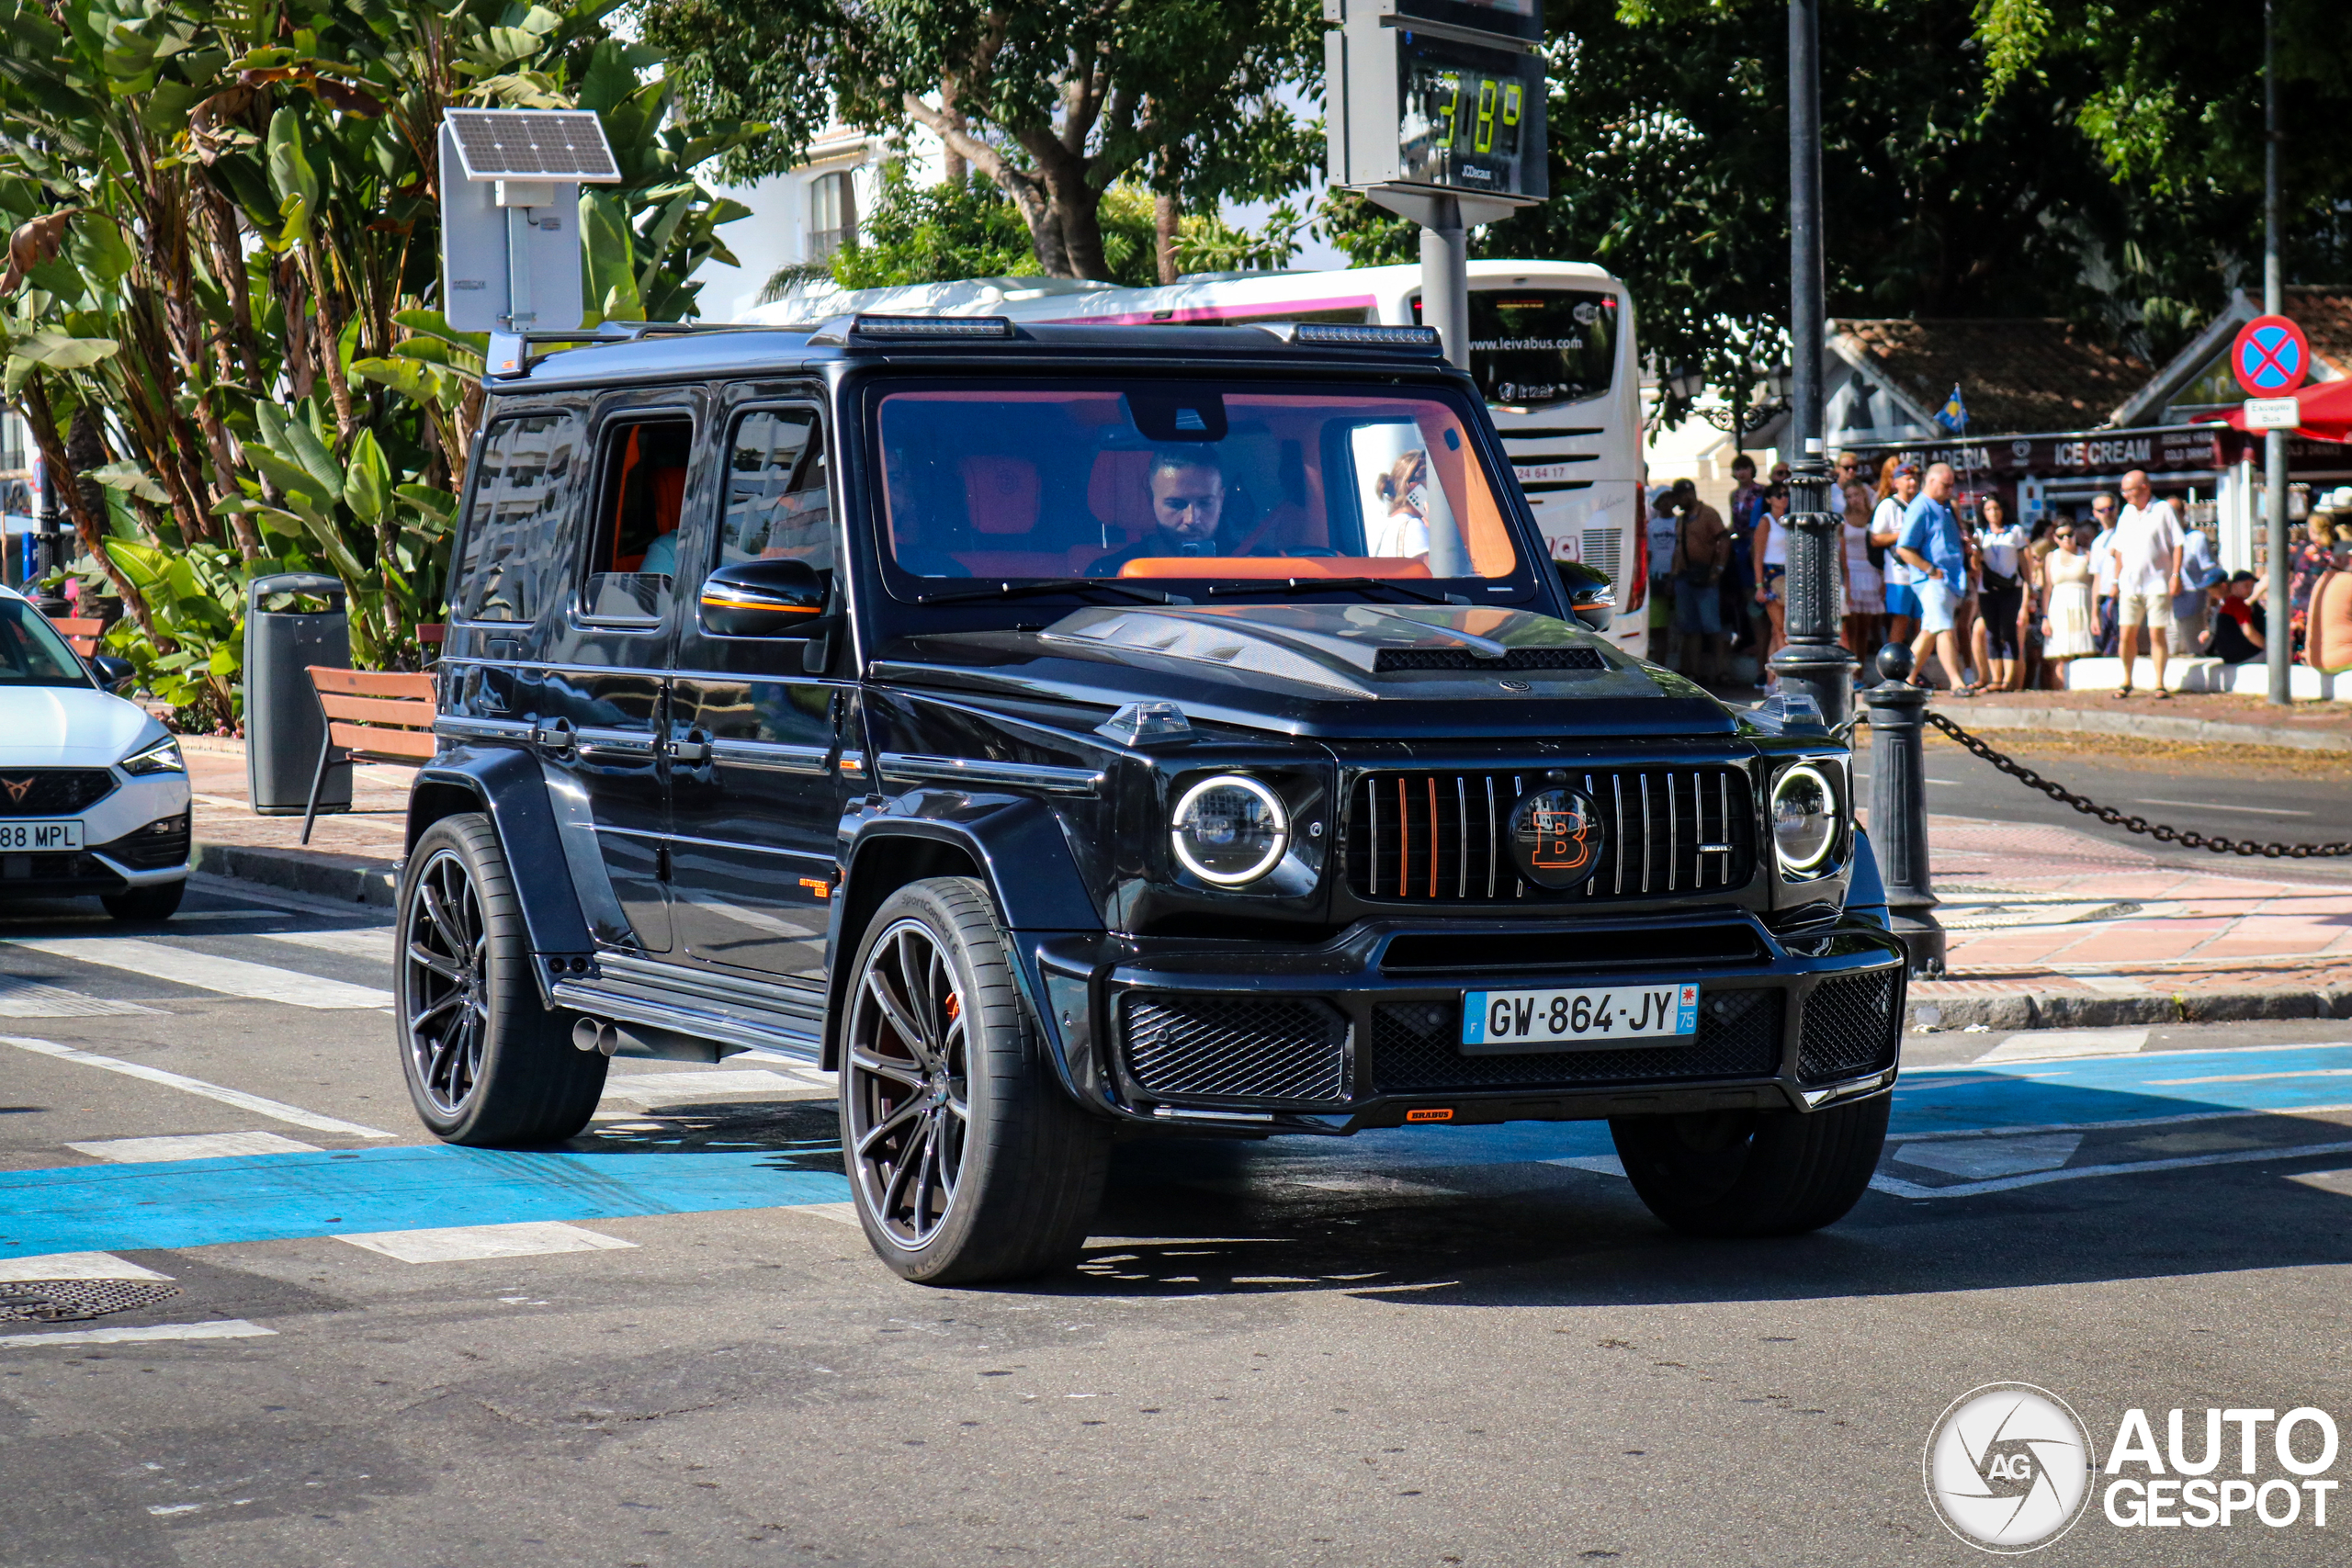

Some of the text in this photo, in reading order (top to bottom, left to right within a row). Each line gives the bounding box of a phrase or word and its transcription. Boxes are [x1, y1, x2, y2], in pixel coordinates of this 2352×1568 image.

[1462, 164, 1491, 180] JCDecaux
[2054, 438, 2152, 466] ICE CREAM
[1518, 467, 1565, 479] 24 64 17
[35, 826, 76, 846] MPL
[1532, 812, 1589, 869] B
[901, 894, 959, 955] SportContact 6
[1489, 992, 1672, 1037] GW-864-JY
[1679, 1011, 1694, 1029] 75
[1470, 1022, 1477, 1034] F
[1411, 1111, 1449, 1119] BRABUS
